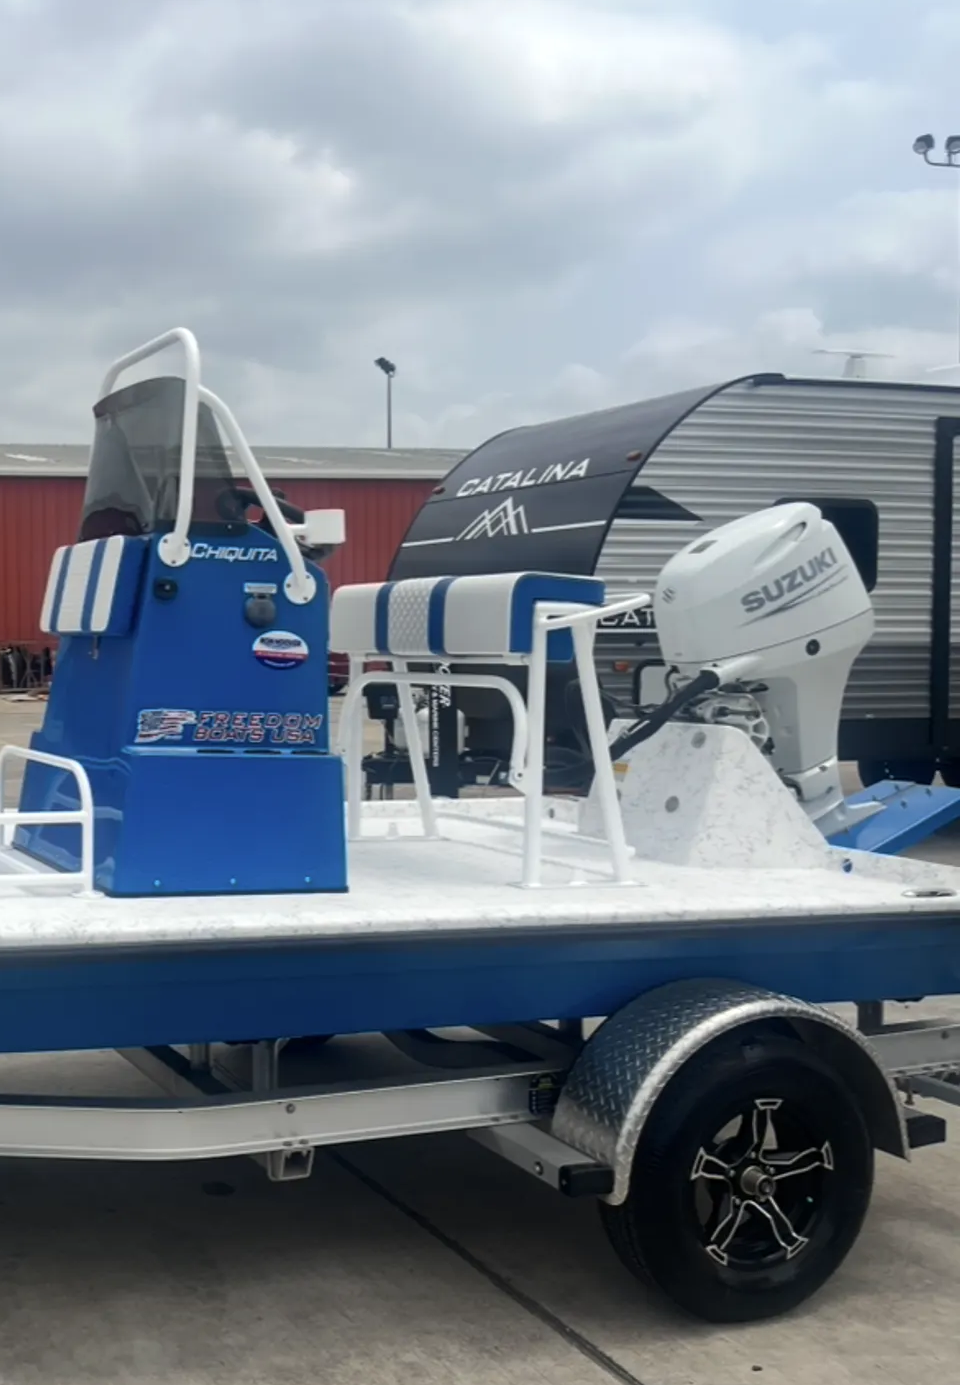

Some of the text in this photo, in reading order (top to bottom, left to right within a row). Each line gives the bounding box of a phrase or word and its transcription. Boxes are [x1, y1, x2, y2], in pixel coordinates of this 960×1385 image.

[456, 457, 590, 497] CATALINA
[191, 543, 278, 563] CHIQUITA
[740, 546, 838, 614] SUZUKI
[197, 711, 323, 730] FREEDOM
[193, 726, 316, 744] BOATS USA
